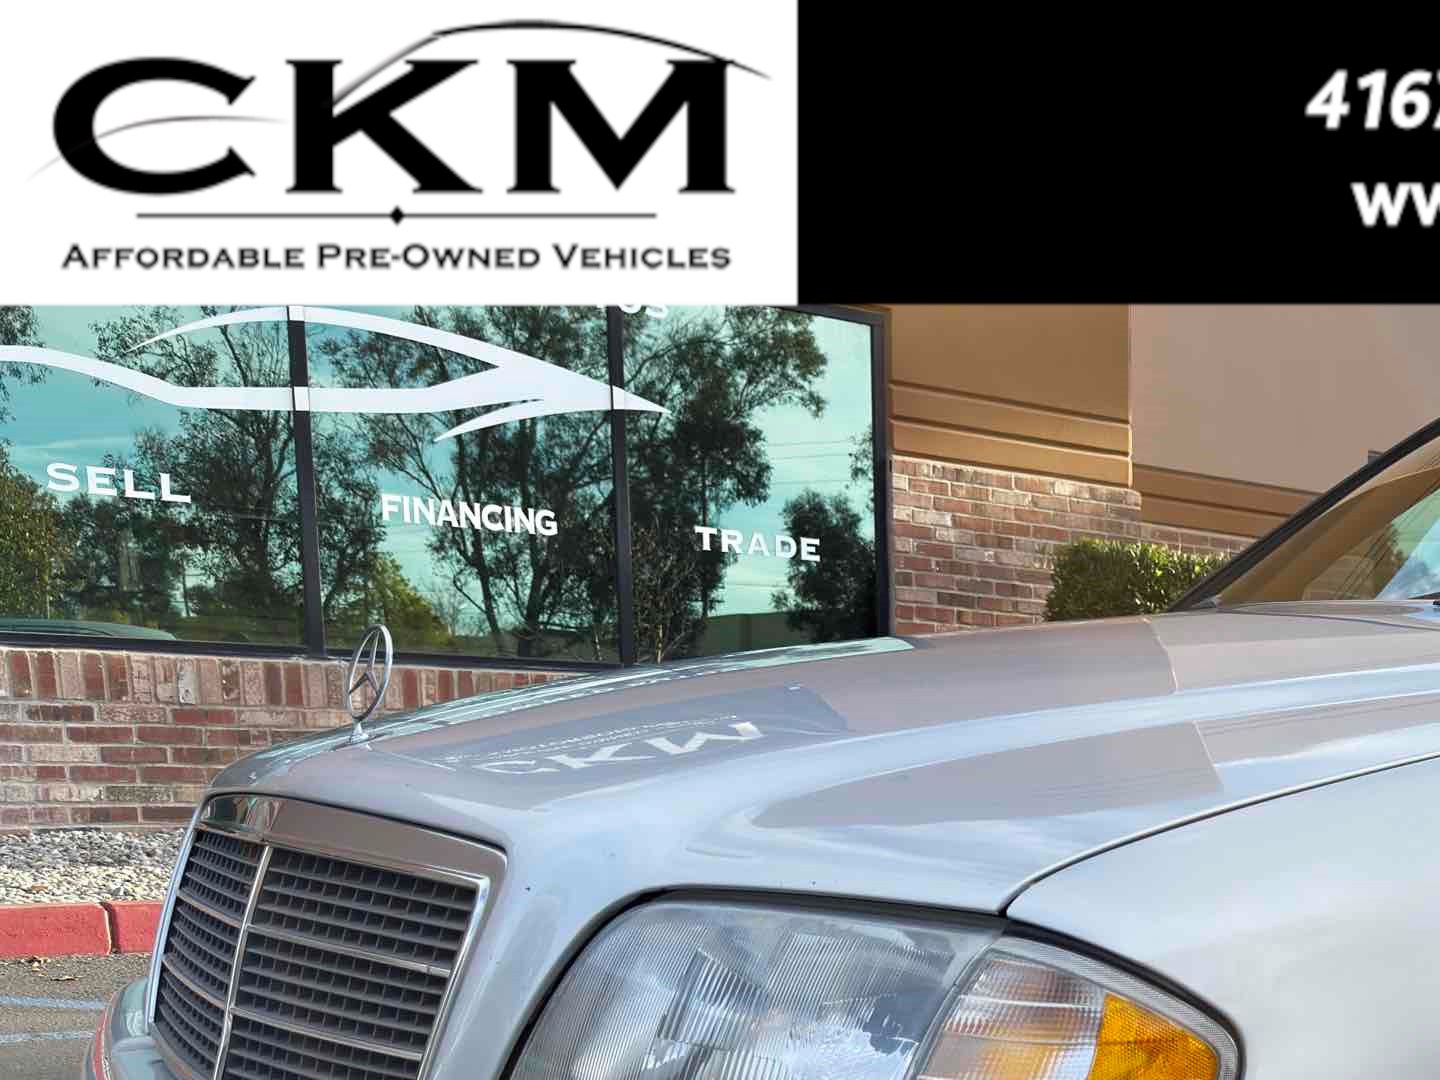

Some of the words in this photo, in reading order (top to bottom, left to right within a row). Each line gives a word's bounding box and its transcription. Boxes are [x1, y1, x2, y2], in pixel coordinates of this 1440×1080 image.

[46, 462, 192, 504] SELL
[380, 493, 559, 537] FINANCING
[694, 526, 821, 563] TRADE
